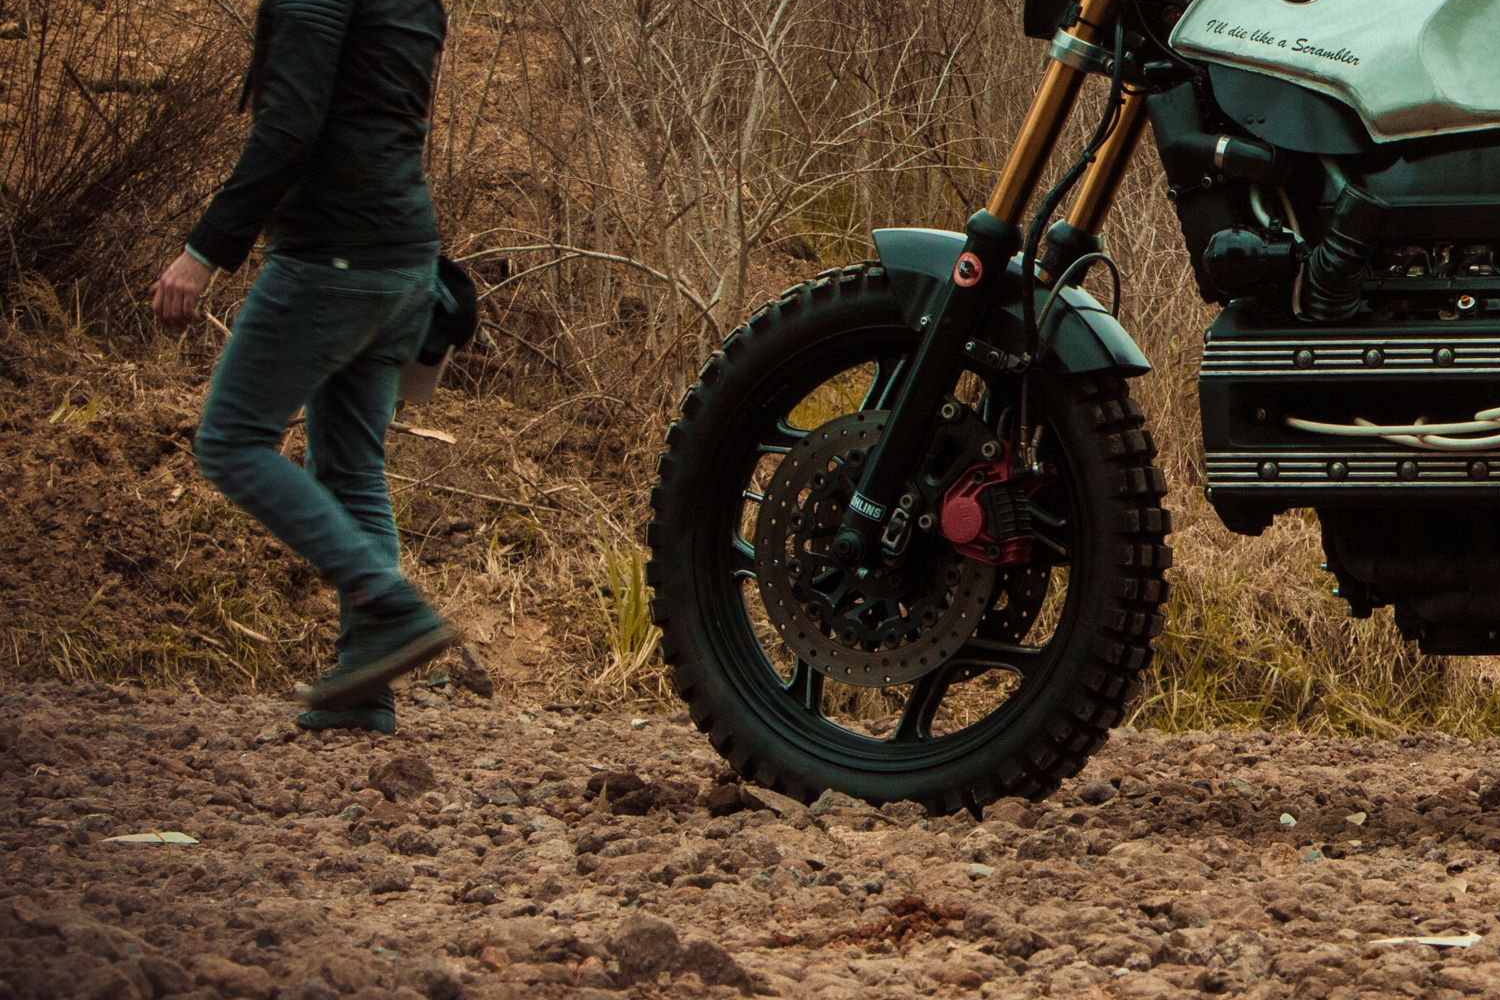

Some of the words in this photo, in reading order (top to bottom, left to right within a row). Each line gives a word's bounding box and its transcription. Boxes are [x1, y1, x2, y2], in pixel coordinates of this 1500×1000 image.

[1206, 19, 1228, 35] I'll
[1228, 25, 1248, 39] die
[1250, 29, 1275, 45] like
[1277, 39, 1288, 48] a
[1291, 38, 1361, 66] Scrambler
